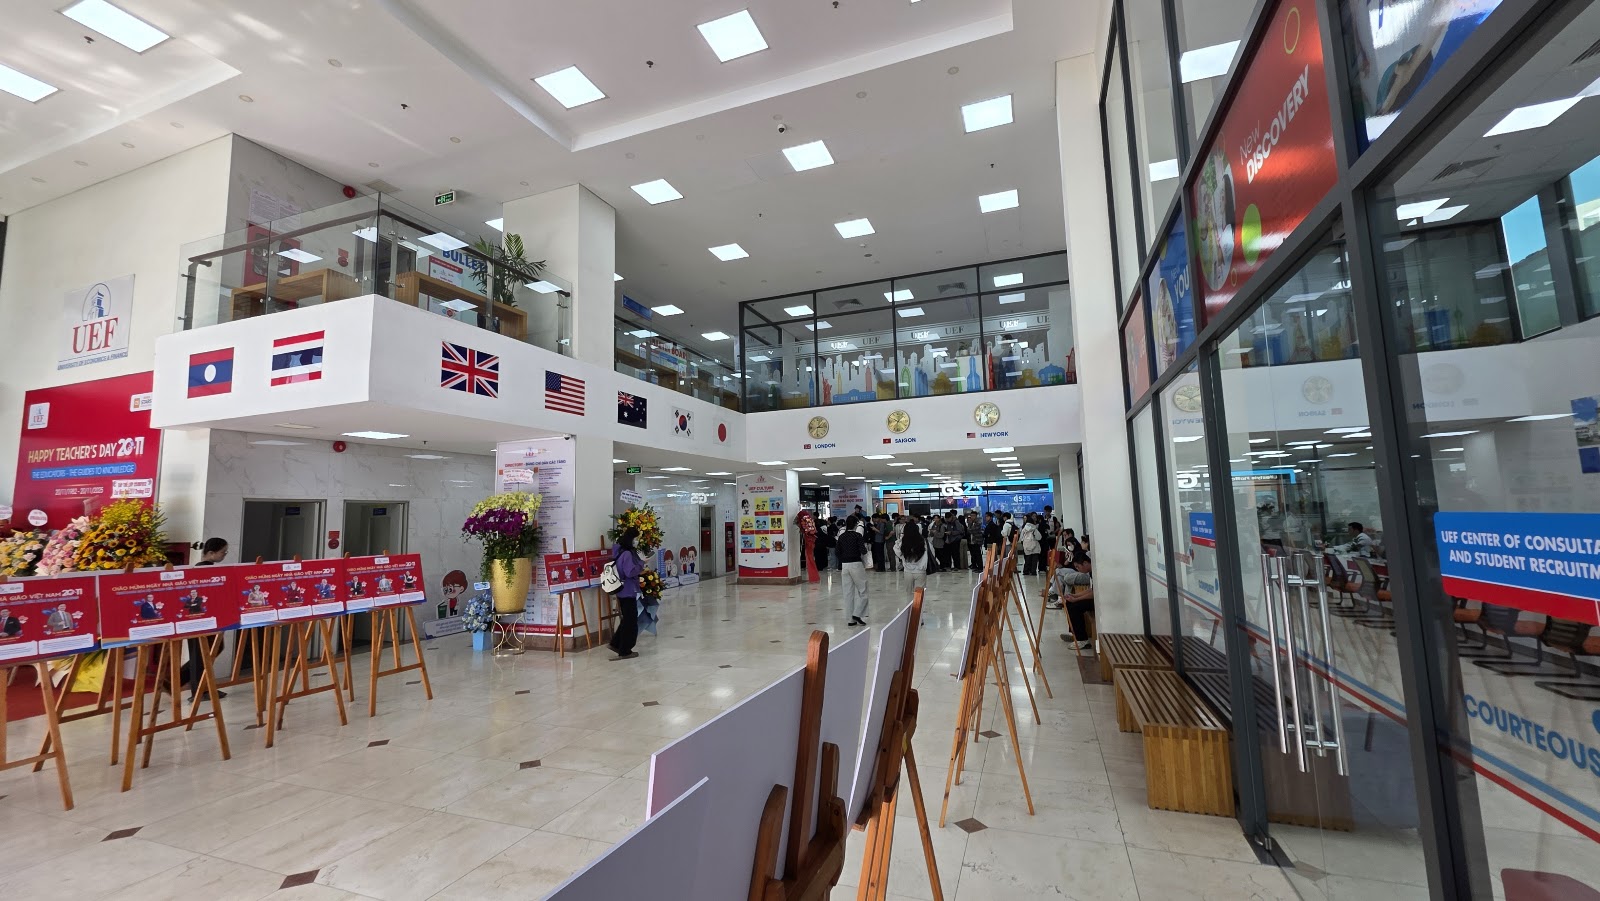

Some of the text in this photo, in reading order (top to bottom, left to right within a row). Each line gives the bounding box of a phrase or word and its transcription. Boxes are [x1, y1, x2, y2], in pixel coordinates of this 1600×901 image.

[1246, 64, 1308, 184] DISCOVERY
[1240, 120, 1259, 165] New
[1174, 264, 1189, 304] YOU
[73, 317, 118, 354] UEF
[862, 336, 881, 345] UEF
[945, 326, 965, 335] UEF
[28, 449, 55, 463] HAPPY
[56, 444, 97, 461] TEACHER'S
[99, 442, 117, 458] DAY
[102, 464, 135, 474] KNOWLEDGE
[941, 482, 983, 496] GS25
[1441, 530, 1458, 544] UEF
[1460, 531, 1501, 547] CENTER
[1503, 534, 1521, 549] OF
[1449, 550, 1472, 564] AND
[1474, 551, 1526, 571] STUDENT
[1463, 694, 1600, 778] COURTEOUS
